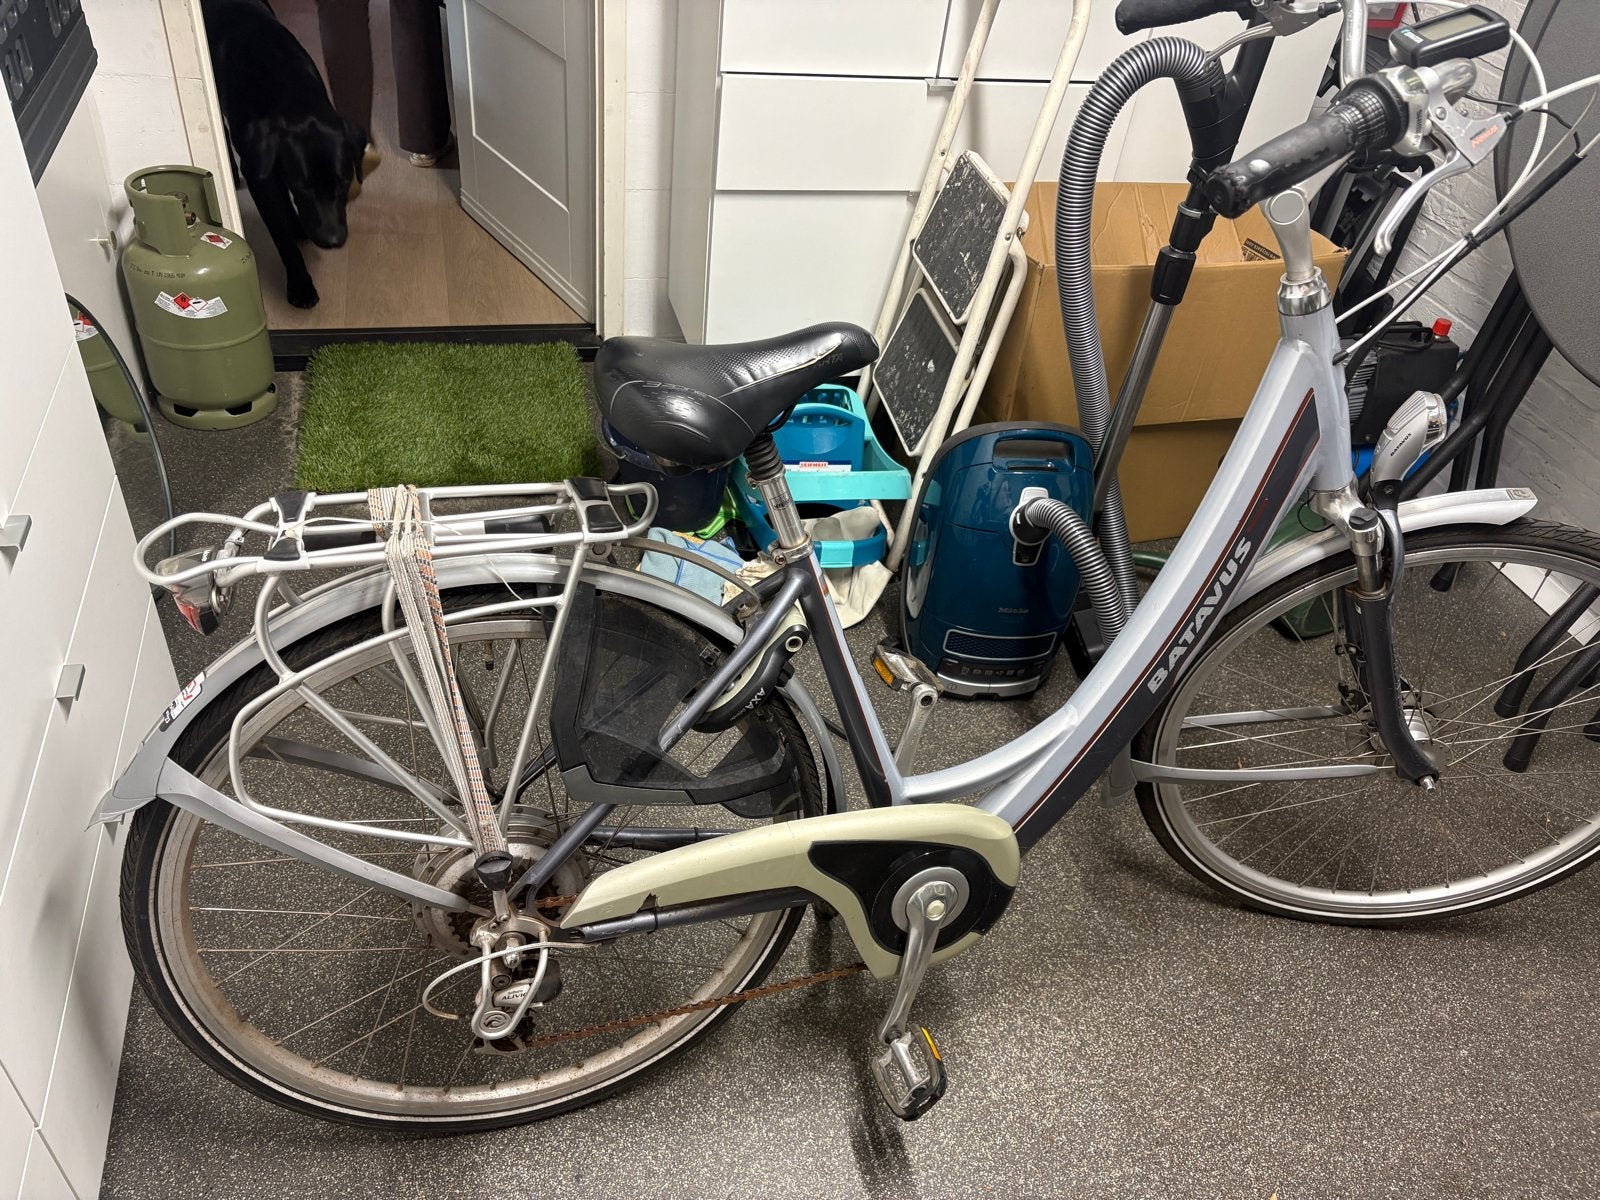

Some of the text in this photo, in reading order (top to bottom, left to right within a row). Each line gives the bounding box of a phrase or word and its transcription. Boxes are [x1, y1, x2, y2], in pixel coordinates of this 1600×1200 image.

[1390, 433, 1412, 457] BATAVUS
[1147, 536, 1252, 694] BATAVUS
[745, 687, 766, 710] AXA
